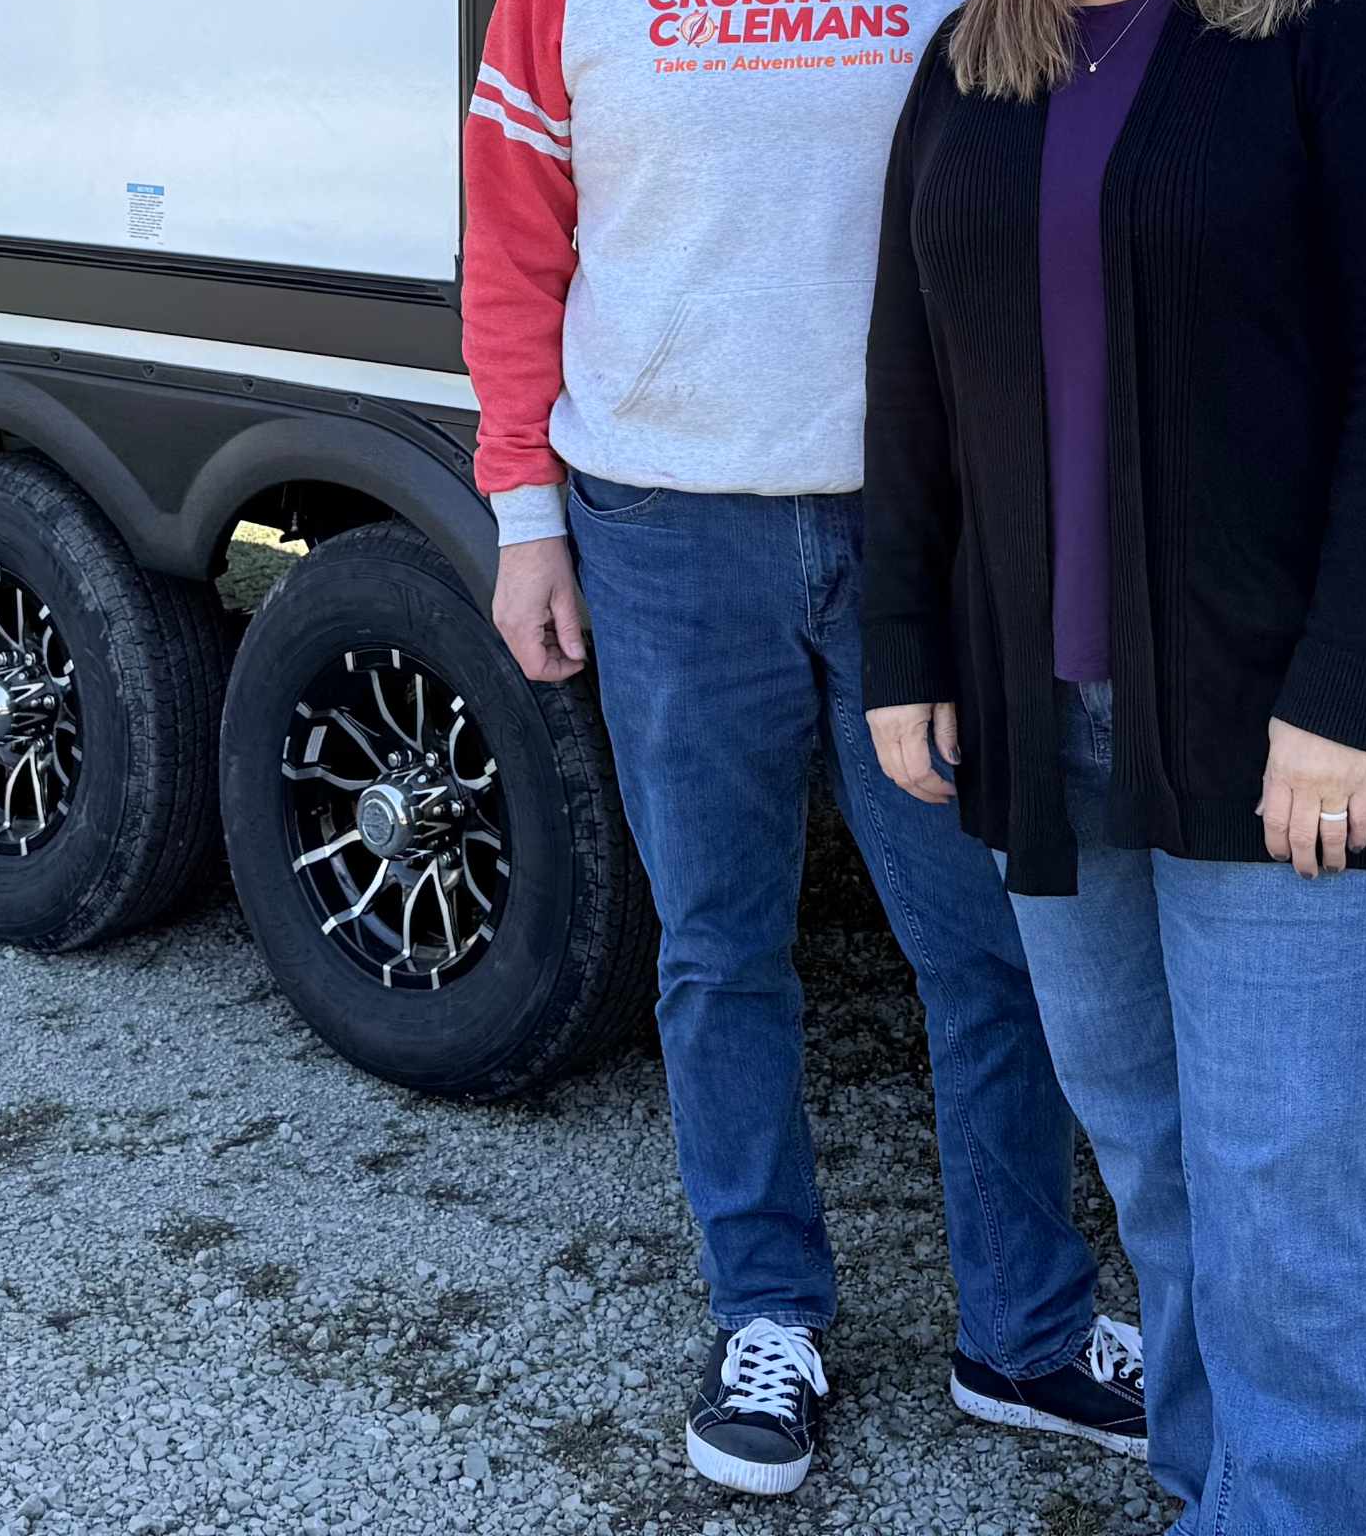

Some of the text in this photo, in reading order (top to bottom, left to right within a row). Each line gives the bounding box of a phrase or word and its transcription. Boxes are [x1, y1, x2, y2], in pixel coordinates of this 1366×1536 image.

[654, 47, 914, 73] Take an Adventure with Us
